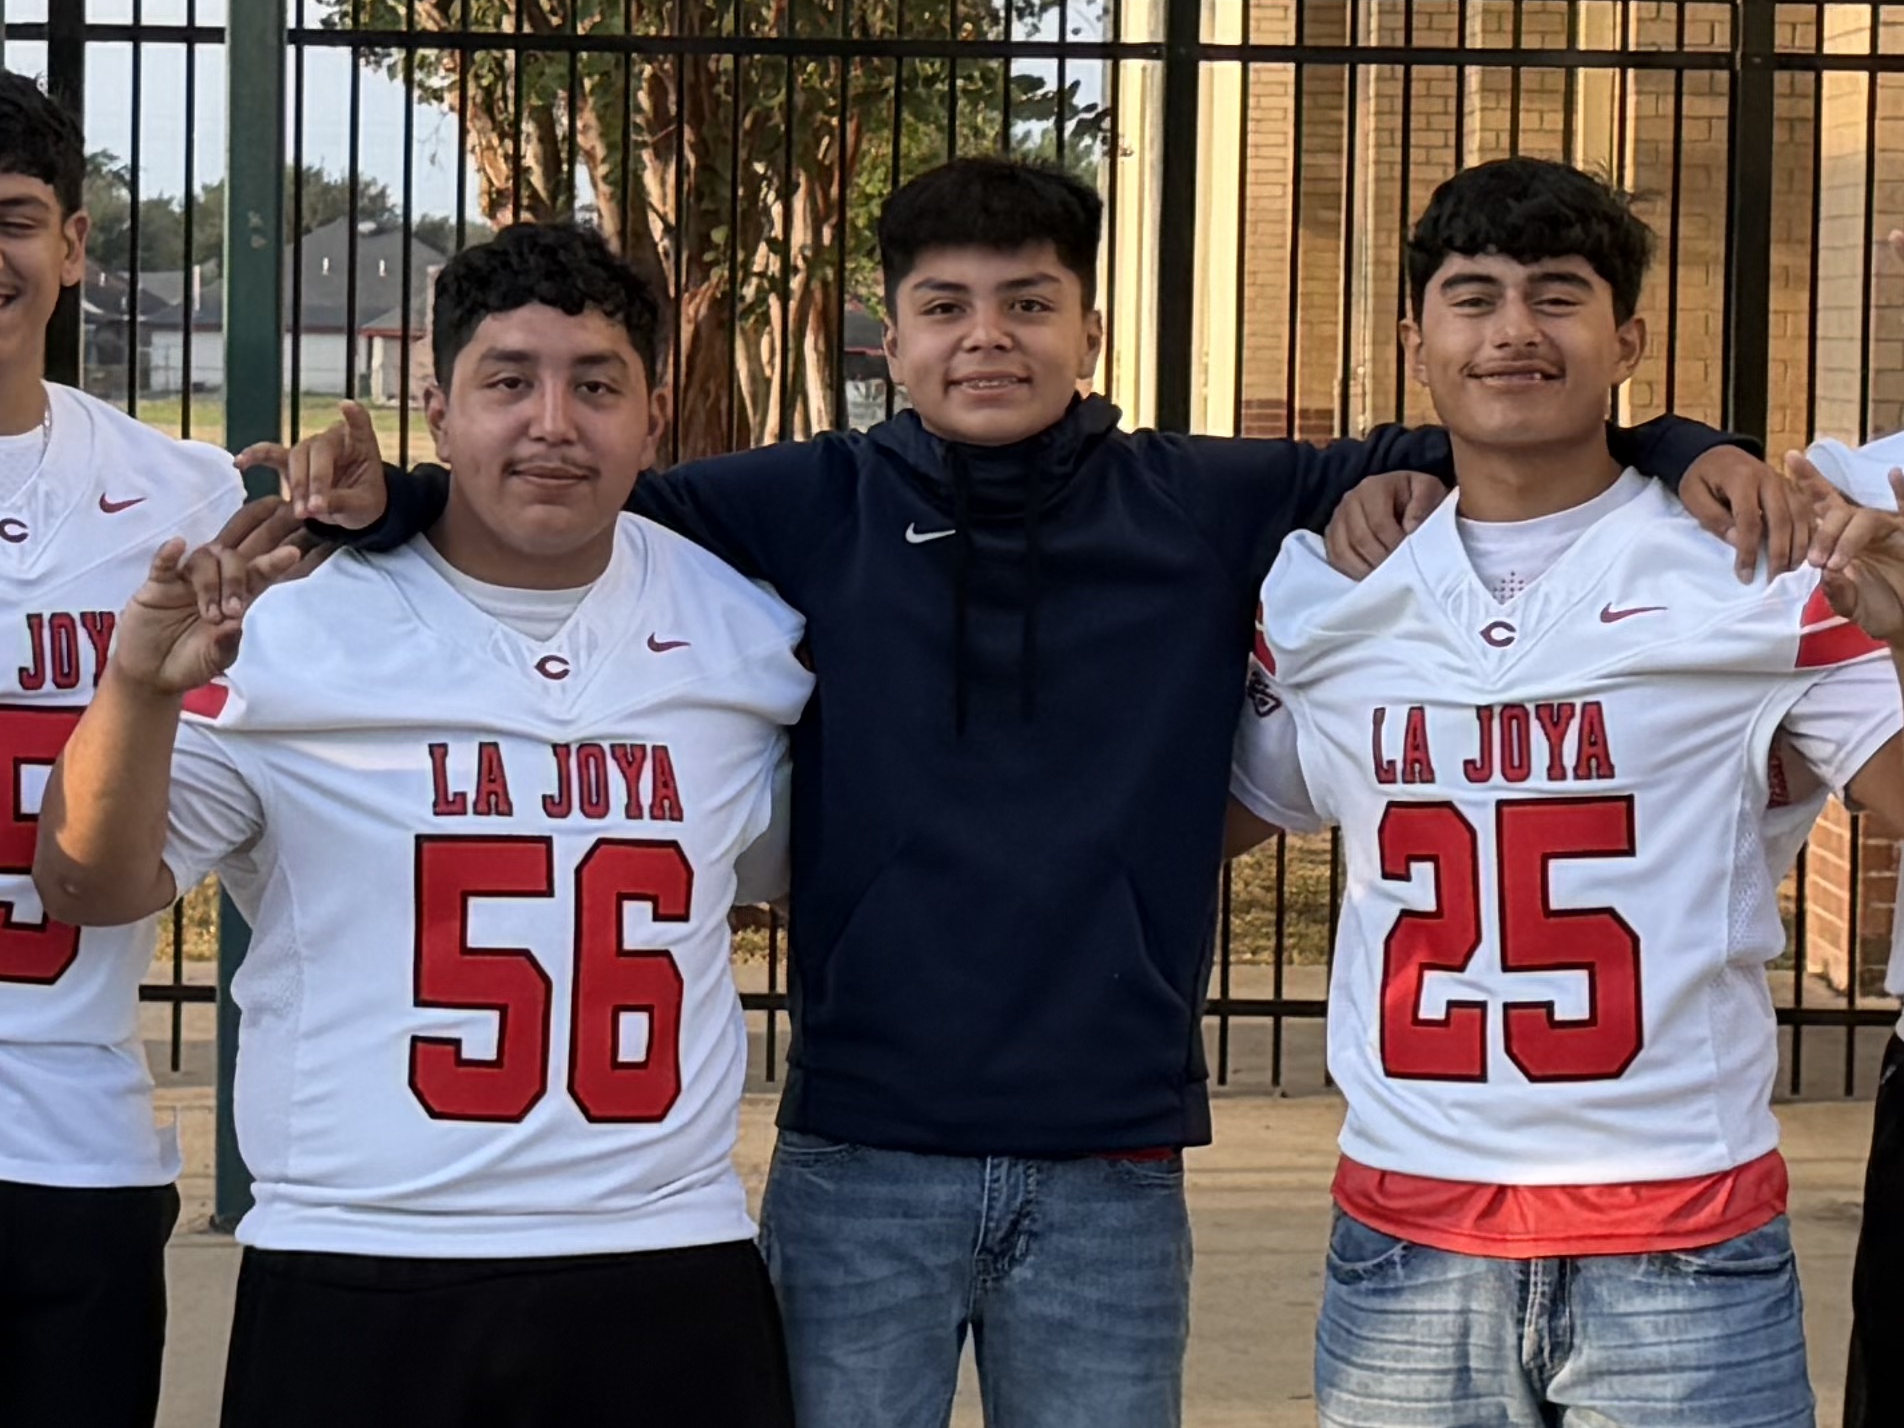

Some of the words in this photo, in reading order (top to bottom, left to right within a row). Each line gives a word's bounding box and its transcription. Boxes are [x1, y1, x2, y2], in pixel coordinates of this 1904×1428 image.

[17, 611, 116, 690] JOY
[534, 654, 570, 681] C
[1480, 621, 1516, 648] C
[428, 742, 513, 817] LA
[542, 743, 684, 822] JOYA
[1372, 705, 1435, 784] LA
[1463, 701, 1615, 782] JOYA
[1378, 794, 1644, 1083] 25
[408, 834, 695, 1124] 56
